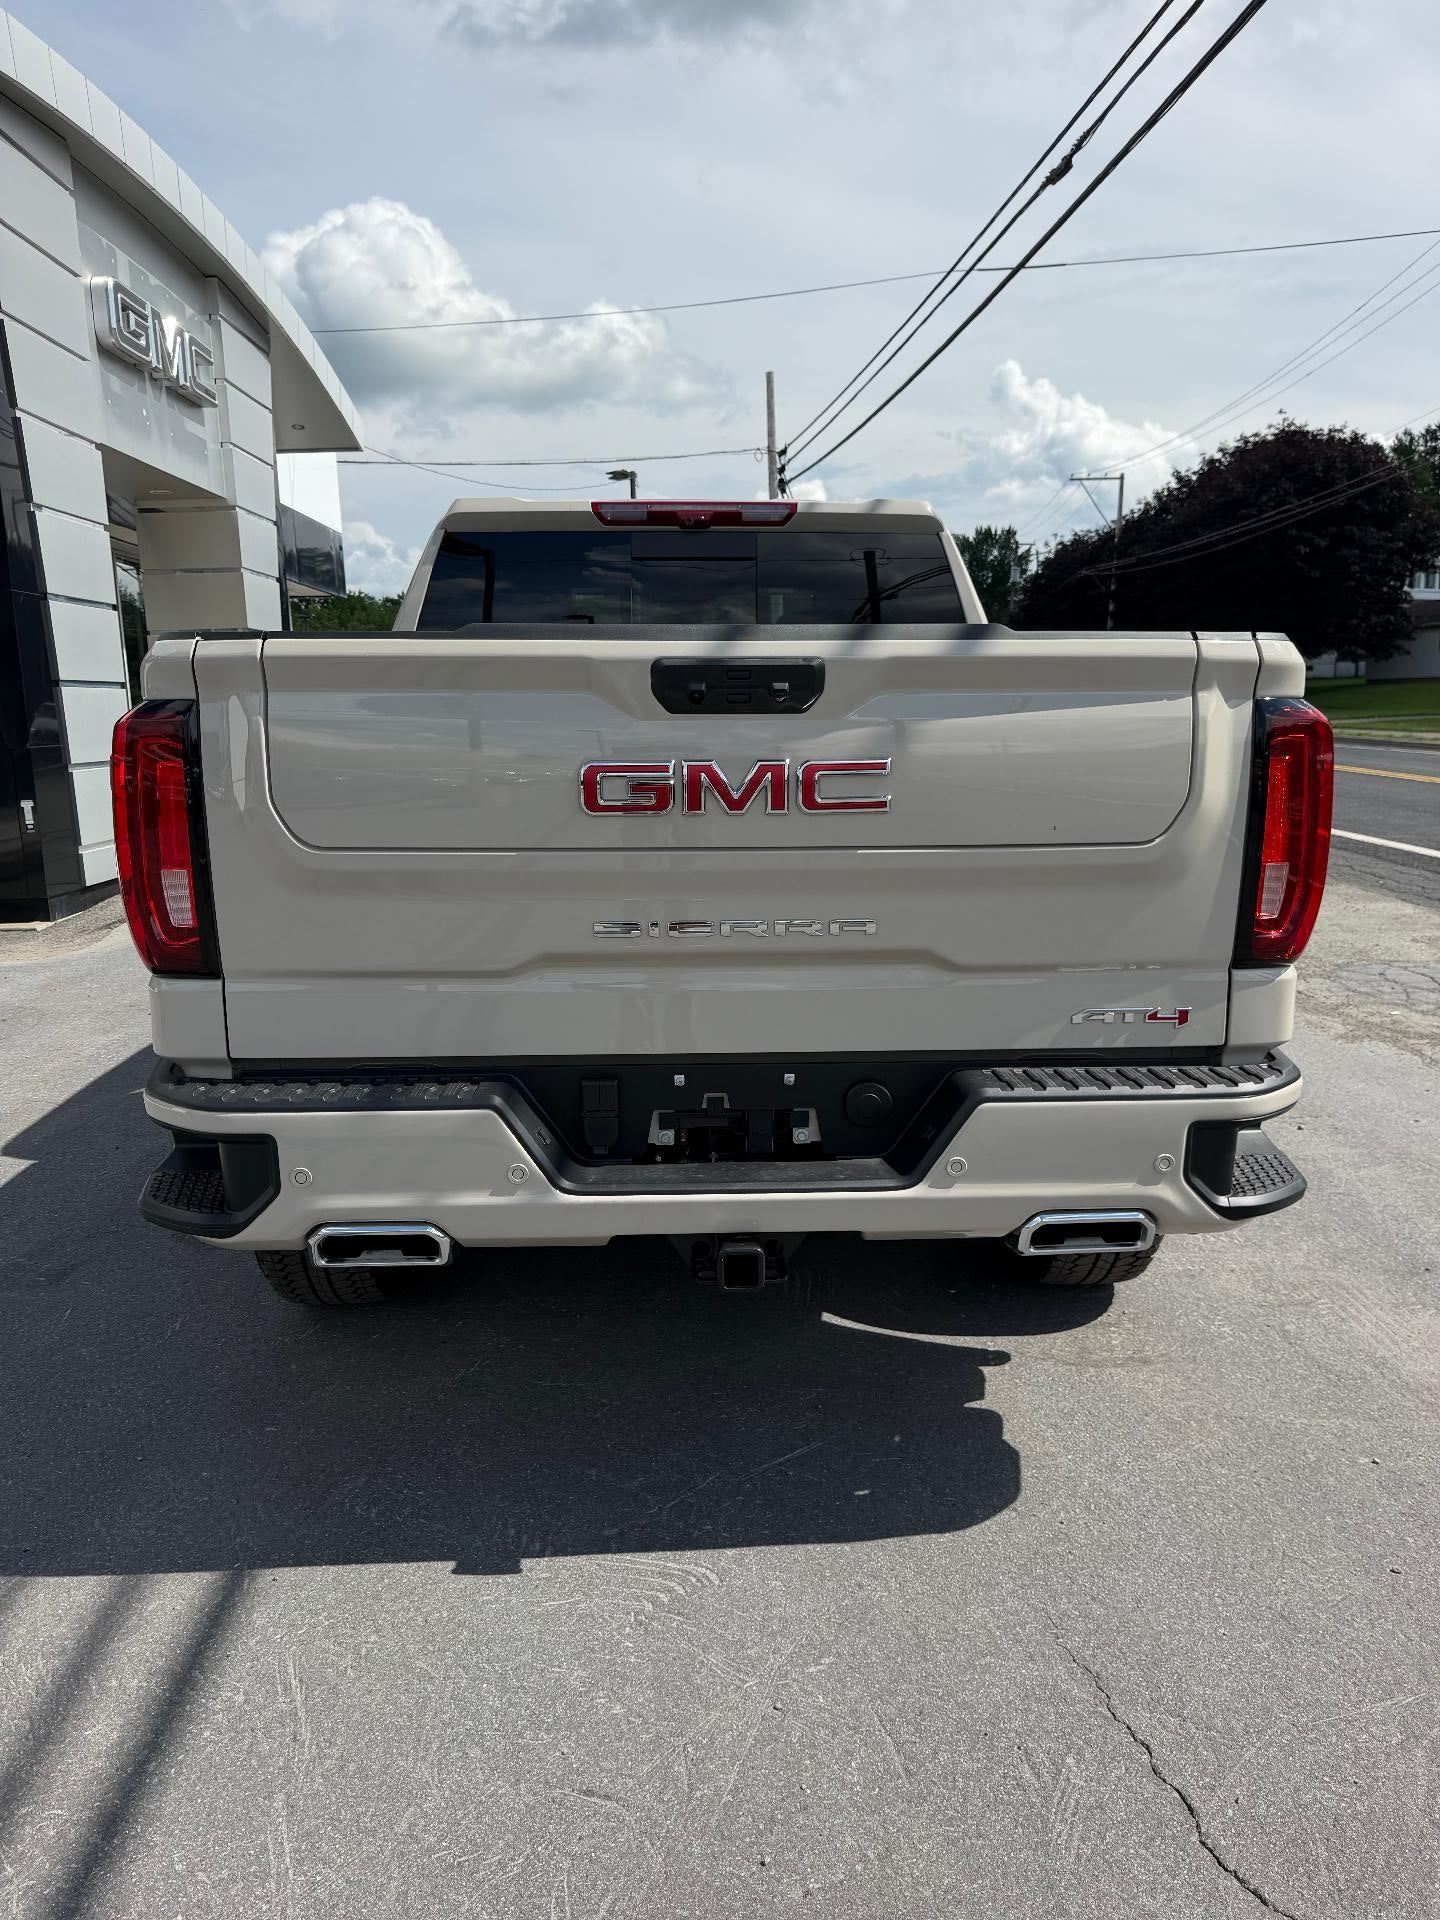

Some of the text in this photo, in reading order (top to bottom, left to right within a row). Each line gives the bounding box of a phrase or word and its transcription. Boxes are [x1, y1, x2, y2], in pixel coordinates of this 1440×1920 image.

[92, 276, 218, 407] GMC
[580, 758, 892, 816] GMC
[592, 919, 878, 938] SIERRA
[1071, 1007, 1192, 1028] AT4
